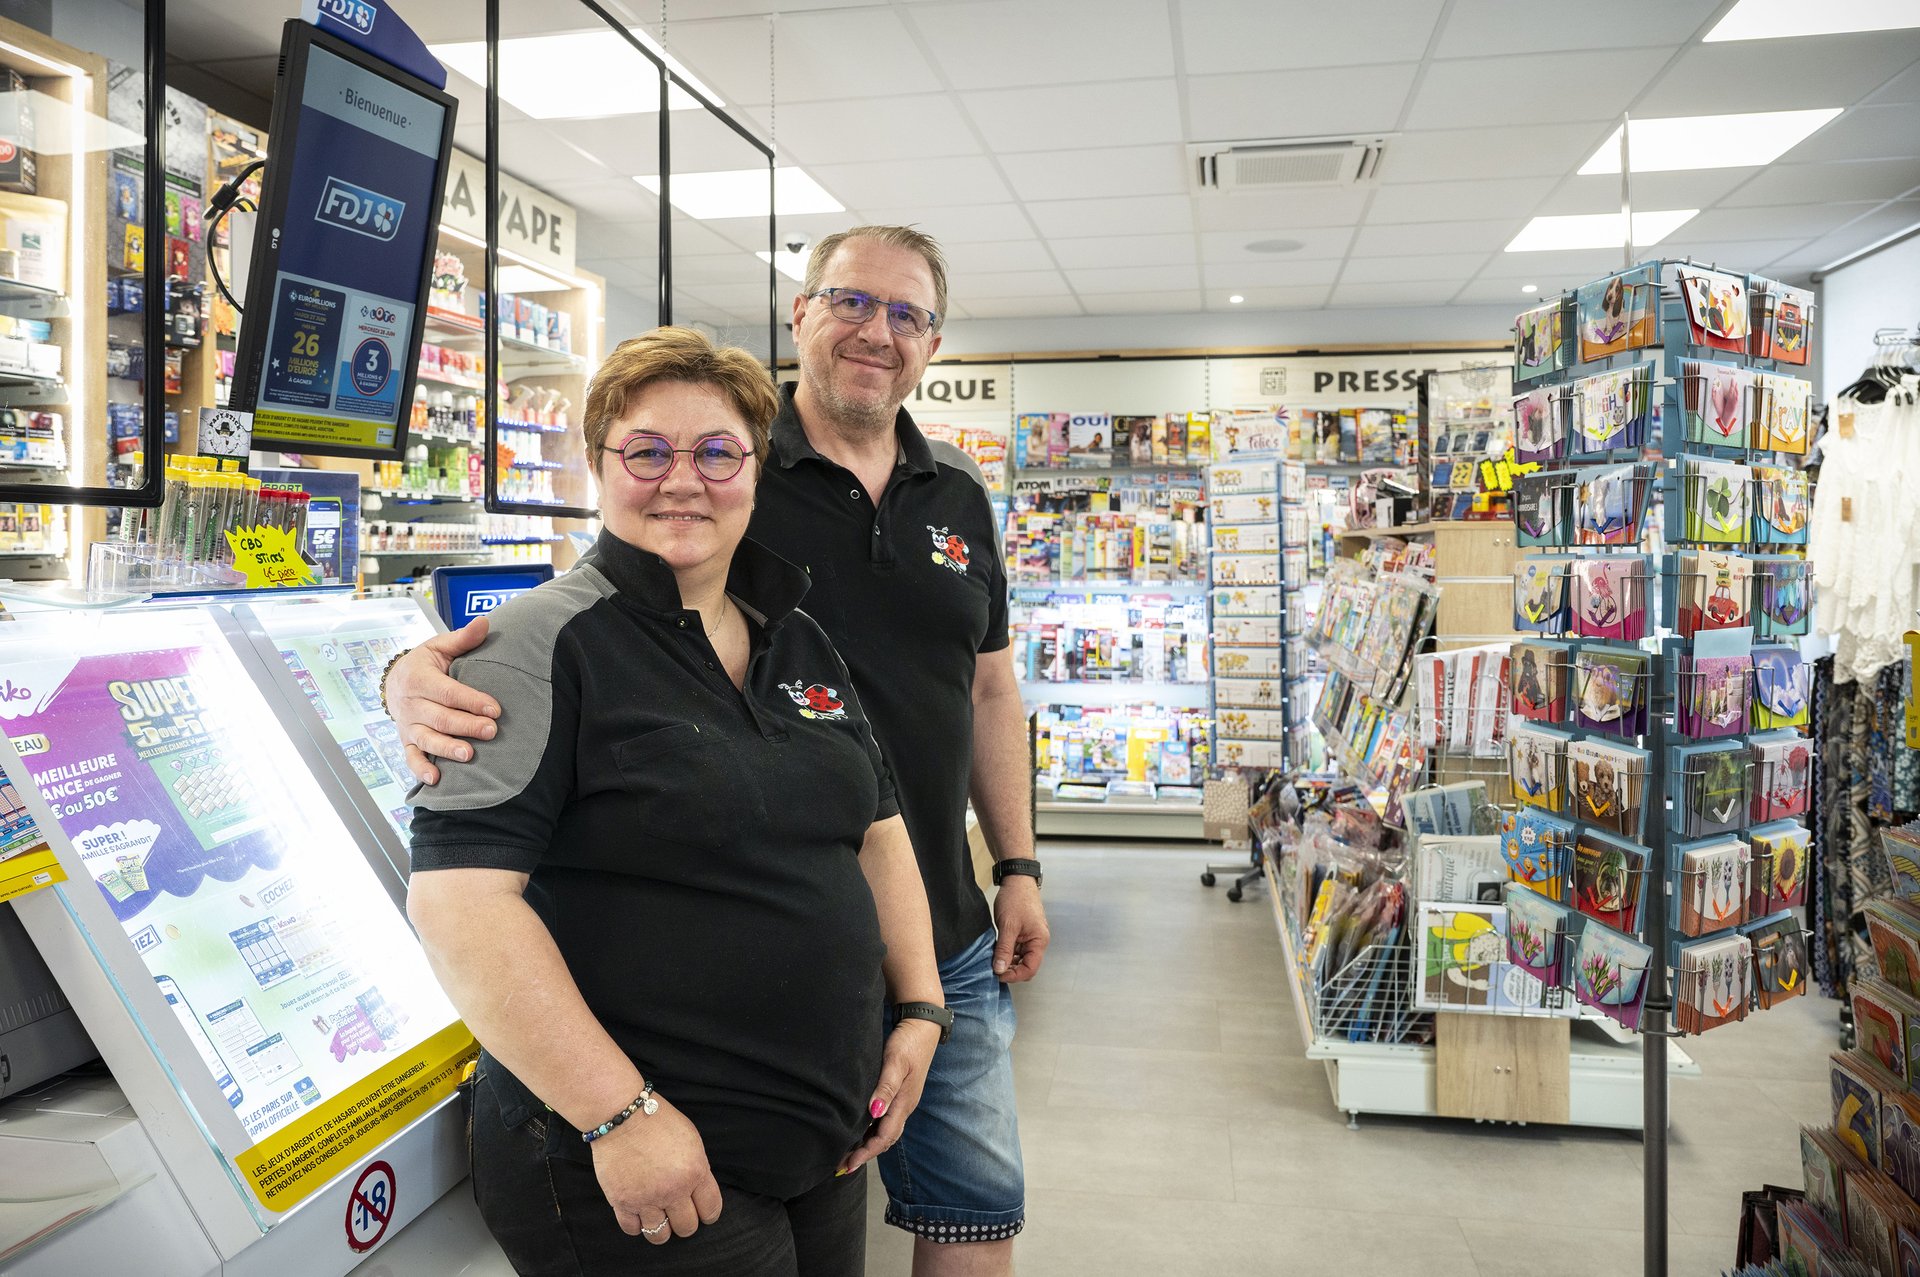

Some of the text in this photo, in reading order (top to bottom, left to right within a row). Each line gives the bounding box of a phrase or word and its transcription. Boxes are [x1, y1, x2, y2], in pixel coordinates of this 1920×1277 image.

[322, 0, 355, 20] FDJ
[345, 88, 407, 128] Bienvenue
[444, 169, 476, 217] A
[324, 187, 374, 225] FDJ
[271, 238, 278, 249] LG
[298, 294, 336, 309] EUROMILLIONS
[370, 307, 396, 323] LOTO
[291, 331, 320, 357] 26
[287, 365, 317, 376] D'EUROS
[288, 357, 319, 368] MILLIONS
[366, 349, 380, 372] 3
[916, 379, 996, 404] IQUE
[1314, 369, 1437, 393] PRESS
[225, 412, 241, 431] STICK
[312, 529, 336, 545] 5€
[0, 679, 32, 702] iko
[108, 677, 205, 721] SUPE
[14, 736, 43, 753] EAU
[33, 753, 118, 787] MEILLEURE
[41, 771, 122, 801] ANCE DE GAGNER
[65, 801, 83, 816] OU
[81, 835, 153, 861] AMILLE S'AGRANDIT
[82, 831, 120, 850] SUPER
[263, 878, 294, 904] COCHEZ
[134, 931, 154, 951] IEZ
[280, 999, 297, 1010] Jouez
[297, 991, 311, 1003] aussi
[248, 1100, 301, 1137] 'APPLI OFFICIELLE
[250, 1109, 263, 1123] LES
[261, 1098, 282, 1116] PARIS
[281, 1091, 294, 1105] SUR
[252, 1164, 268, 1178] LES
[268, 1153, 285, 1169] JEUX
[286, 1132, 317, 1157] D'ARGENT
[316, 1127, 325, 1137] ET
[325, 1121, 333, 1132] DE
[333, 1106, 358, 1126] HASARD
[357, 1088, 382, 1109] PEUVENT
[381, 1081, 396, 1094] ÊTRE
[395, 1063, 425, 1084] DANGEREUX
[265, 1171, 304, 1199] RETROUVEZ
[303, 1161, 316, 1175] NOS
[316, 1142, 344, 1165] CONSEILS
[343, 1134, 357, 1147] SUR
[356, 1090, 421, 1139] JOUEURS-INFO-SERVICE.FR
[428, 1080, 435, 1091] 74
[434, 1075, 442, 1085] 75
[441, 1071, 448, 1081] 13
[446, 1068, 453, 1077] 13
[454, 1057, 469, 1071] APPEL
[259, 1166, 286, 1189] PERTES
[285, 1146, 319, 1172] D'ARGENT,
[317, 1126, 348, 1150] CONFLITS
[346, 1105, 380, 1131] FAMILIAUX,
[355, 1180, 387, 1231] -18
